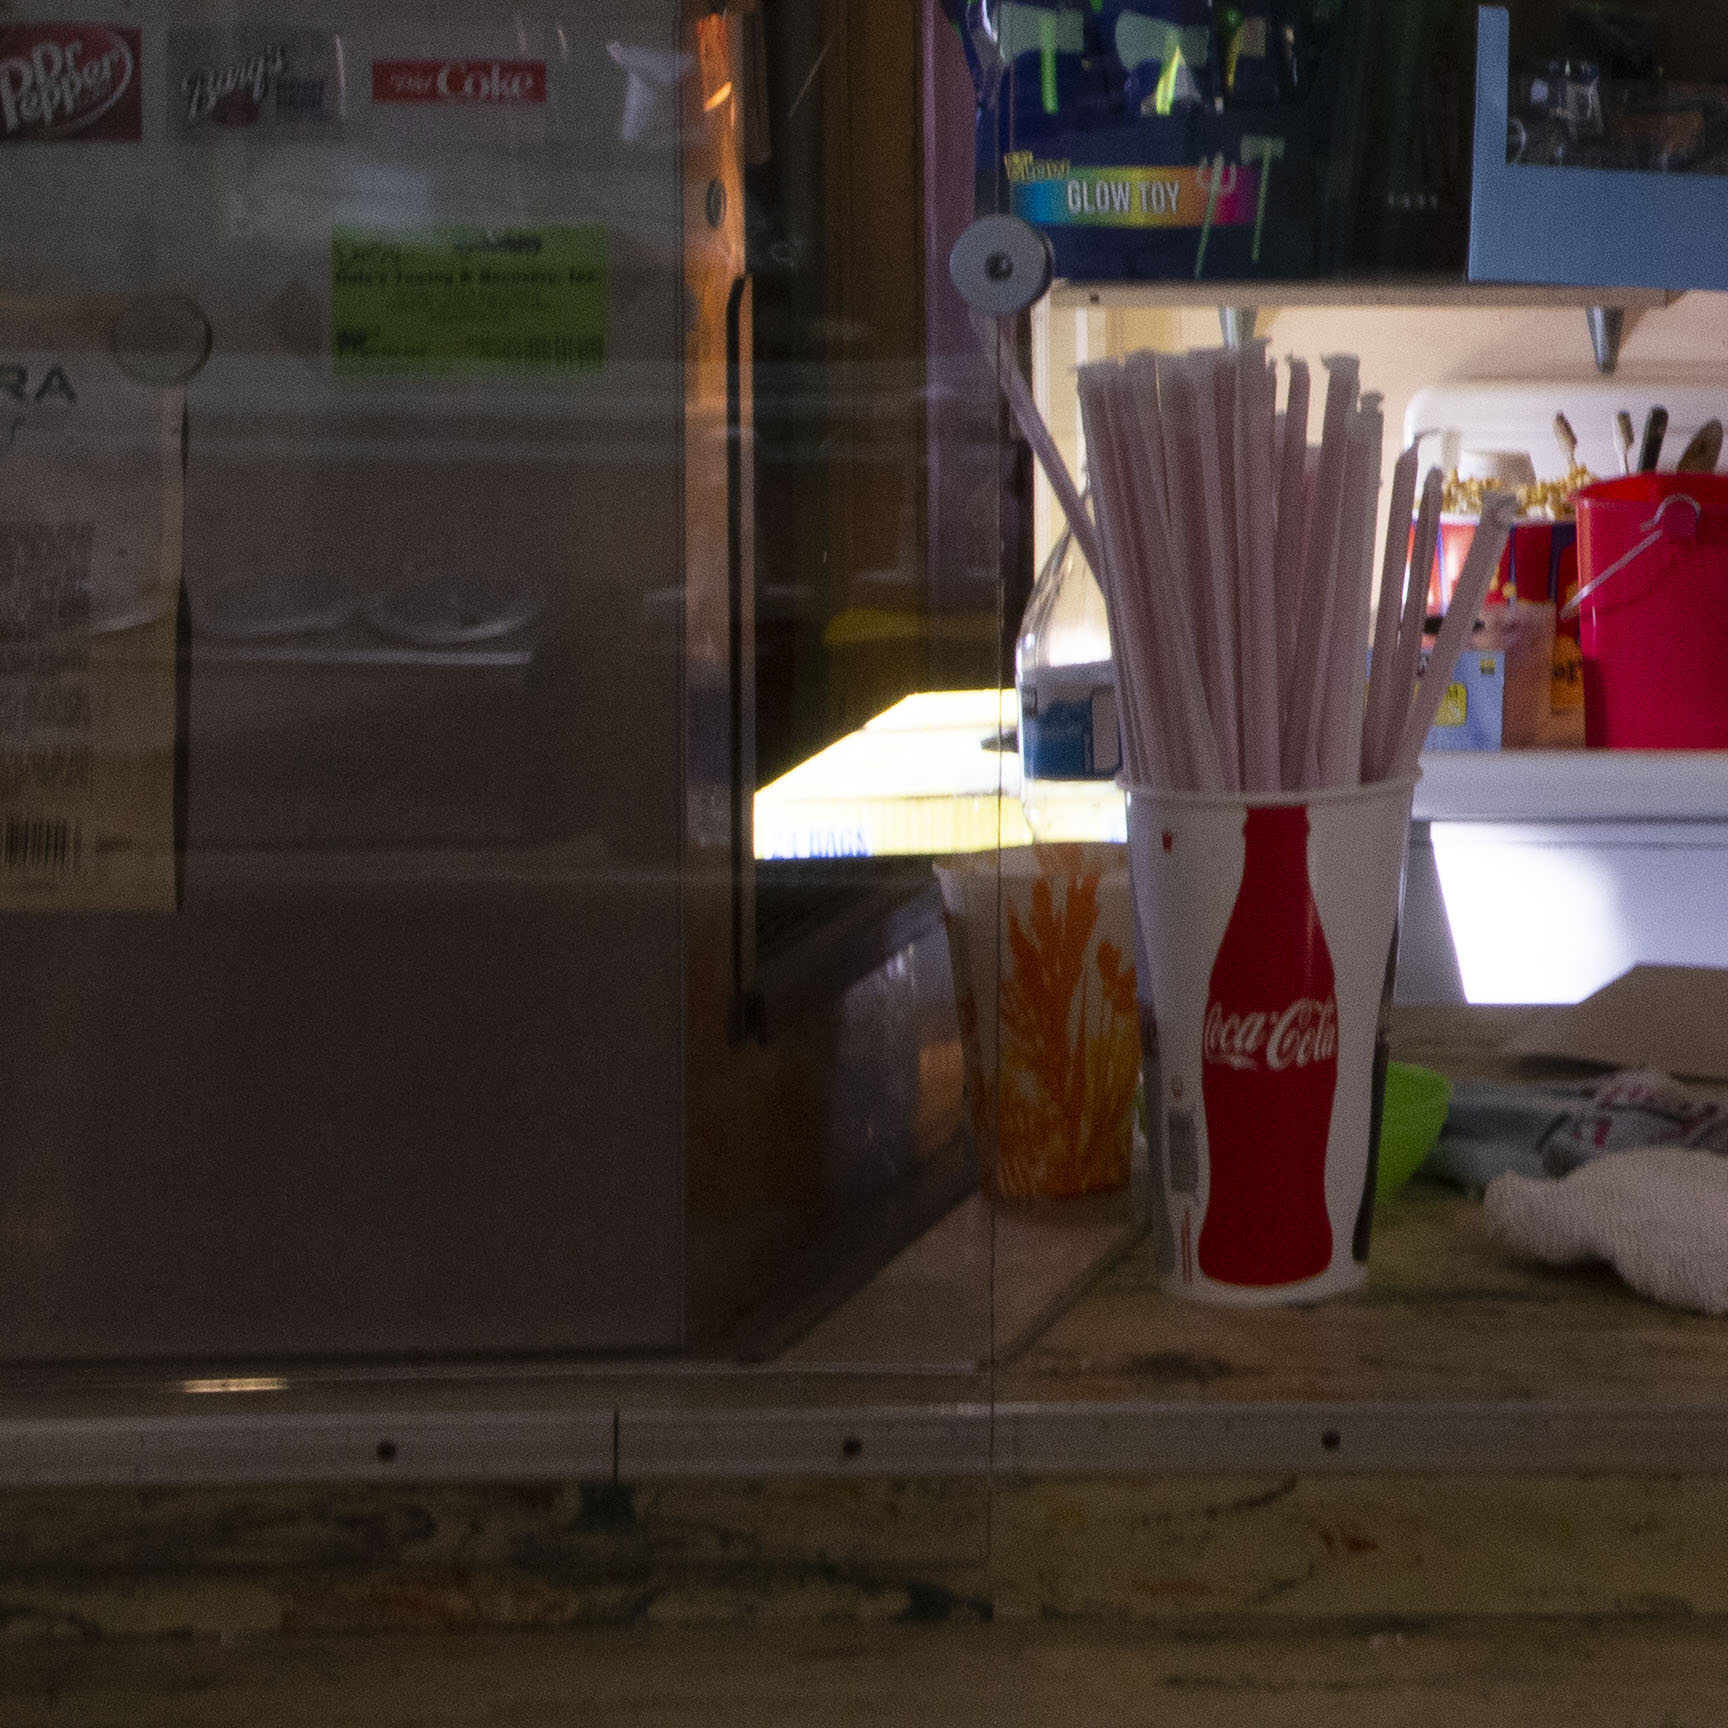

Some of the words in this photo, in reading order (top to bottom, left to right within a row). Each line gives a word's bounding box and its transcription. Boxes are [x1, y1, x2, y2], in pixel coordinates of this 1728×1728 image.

[31, 40, 84, 84] Dr
[437, 63, 534, 99] Coke
[1066, 179, 1132, 216] GLOW
[1138, 180, 1181, 216] TOY
